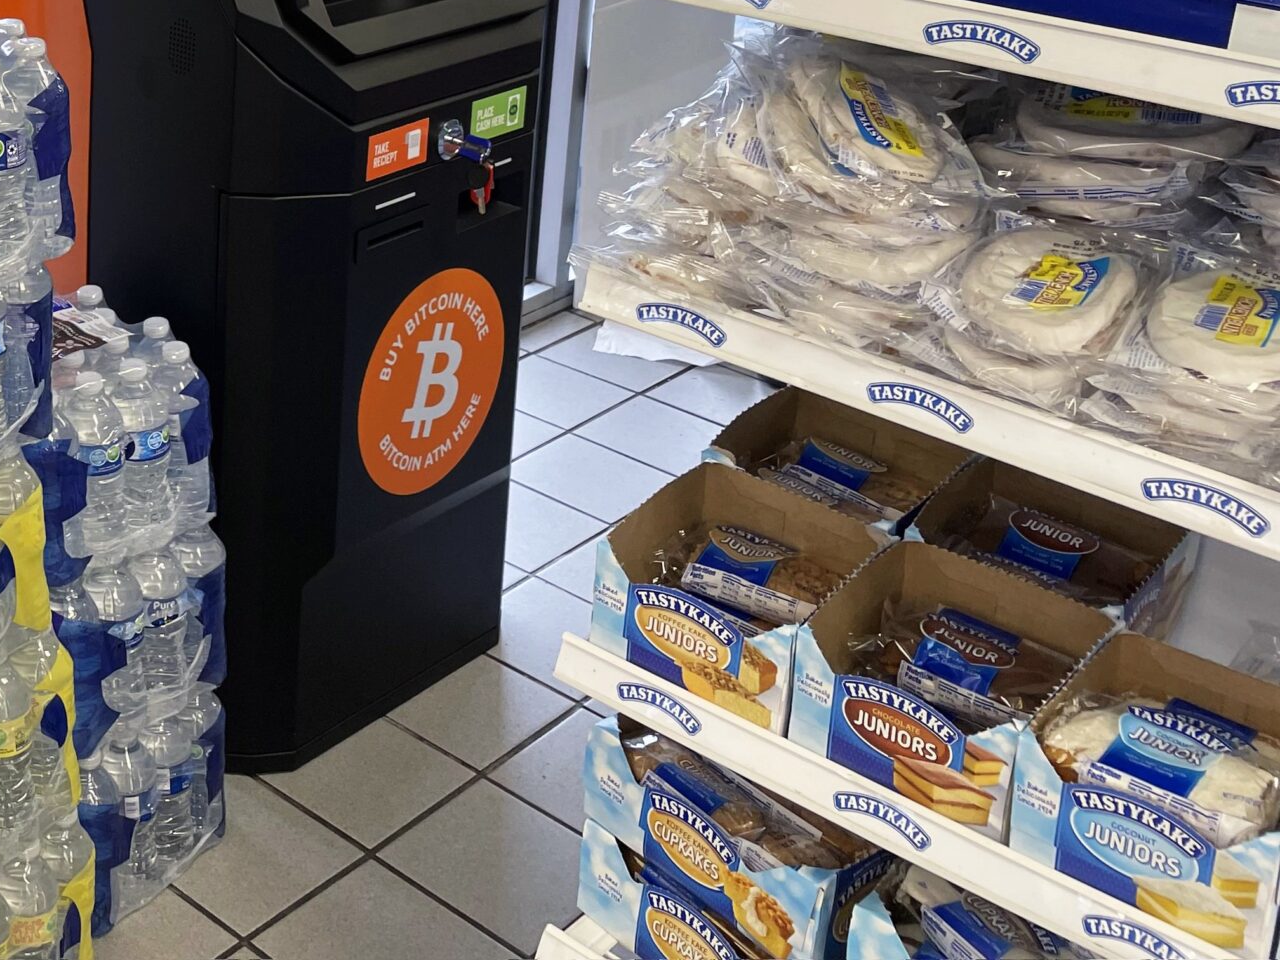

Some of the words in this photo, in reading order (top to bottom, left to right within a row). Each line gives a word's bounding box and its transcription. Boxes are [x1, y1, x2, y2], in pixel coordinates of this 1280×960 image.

[927, 22, 1039, 62] TASTYKAKE
[476, 117, 491, 131] CASH
[492, 114, 505, 126] HERE
[477, 106, 494, 120] PLACE
[373, 151, 398, 168] RECIEPT
[374, 142, 389, 154] TAKE
[380, 334, 405, 381] BUY
[405, 293, 461, 336] BITCOIN
[463, 297, 490, 341] HERE
[639, 306, 724, 345] TASTYKAKE
[379, 434, 423, 471] BITCOIN
[424, 439, 452, 468] ATM
[452, 394, 481, 441] HERE
[871, 385, 971, 431] TASTYKAKE
[1021, 517, 1085, 548] JUNIOR
[1146, 480, 1268, 536] TASTYKAKE
[153, 601, 175, 609] Pure
[638, 590, 736, 646] TASTYKAKE
[645, 616, 718, 663] JUNIORS
[620, 685, 700, 734] TASTYKAKE
[845, 682, 957, 744] TASTYKAKE
[853, 710, 938, 761] JUNIORS
[652, 794, 732, 863] TASTYKAKE
[837, 794, 928, 850] TASTYKAKE
[1075, 792, 1203, 857] TASTYKAKE
[654, 821, 720, 880] CUPKAKES
[1084, 821, 1182, 877] JUNIORS
